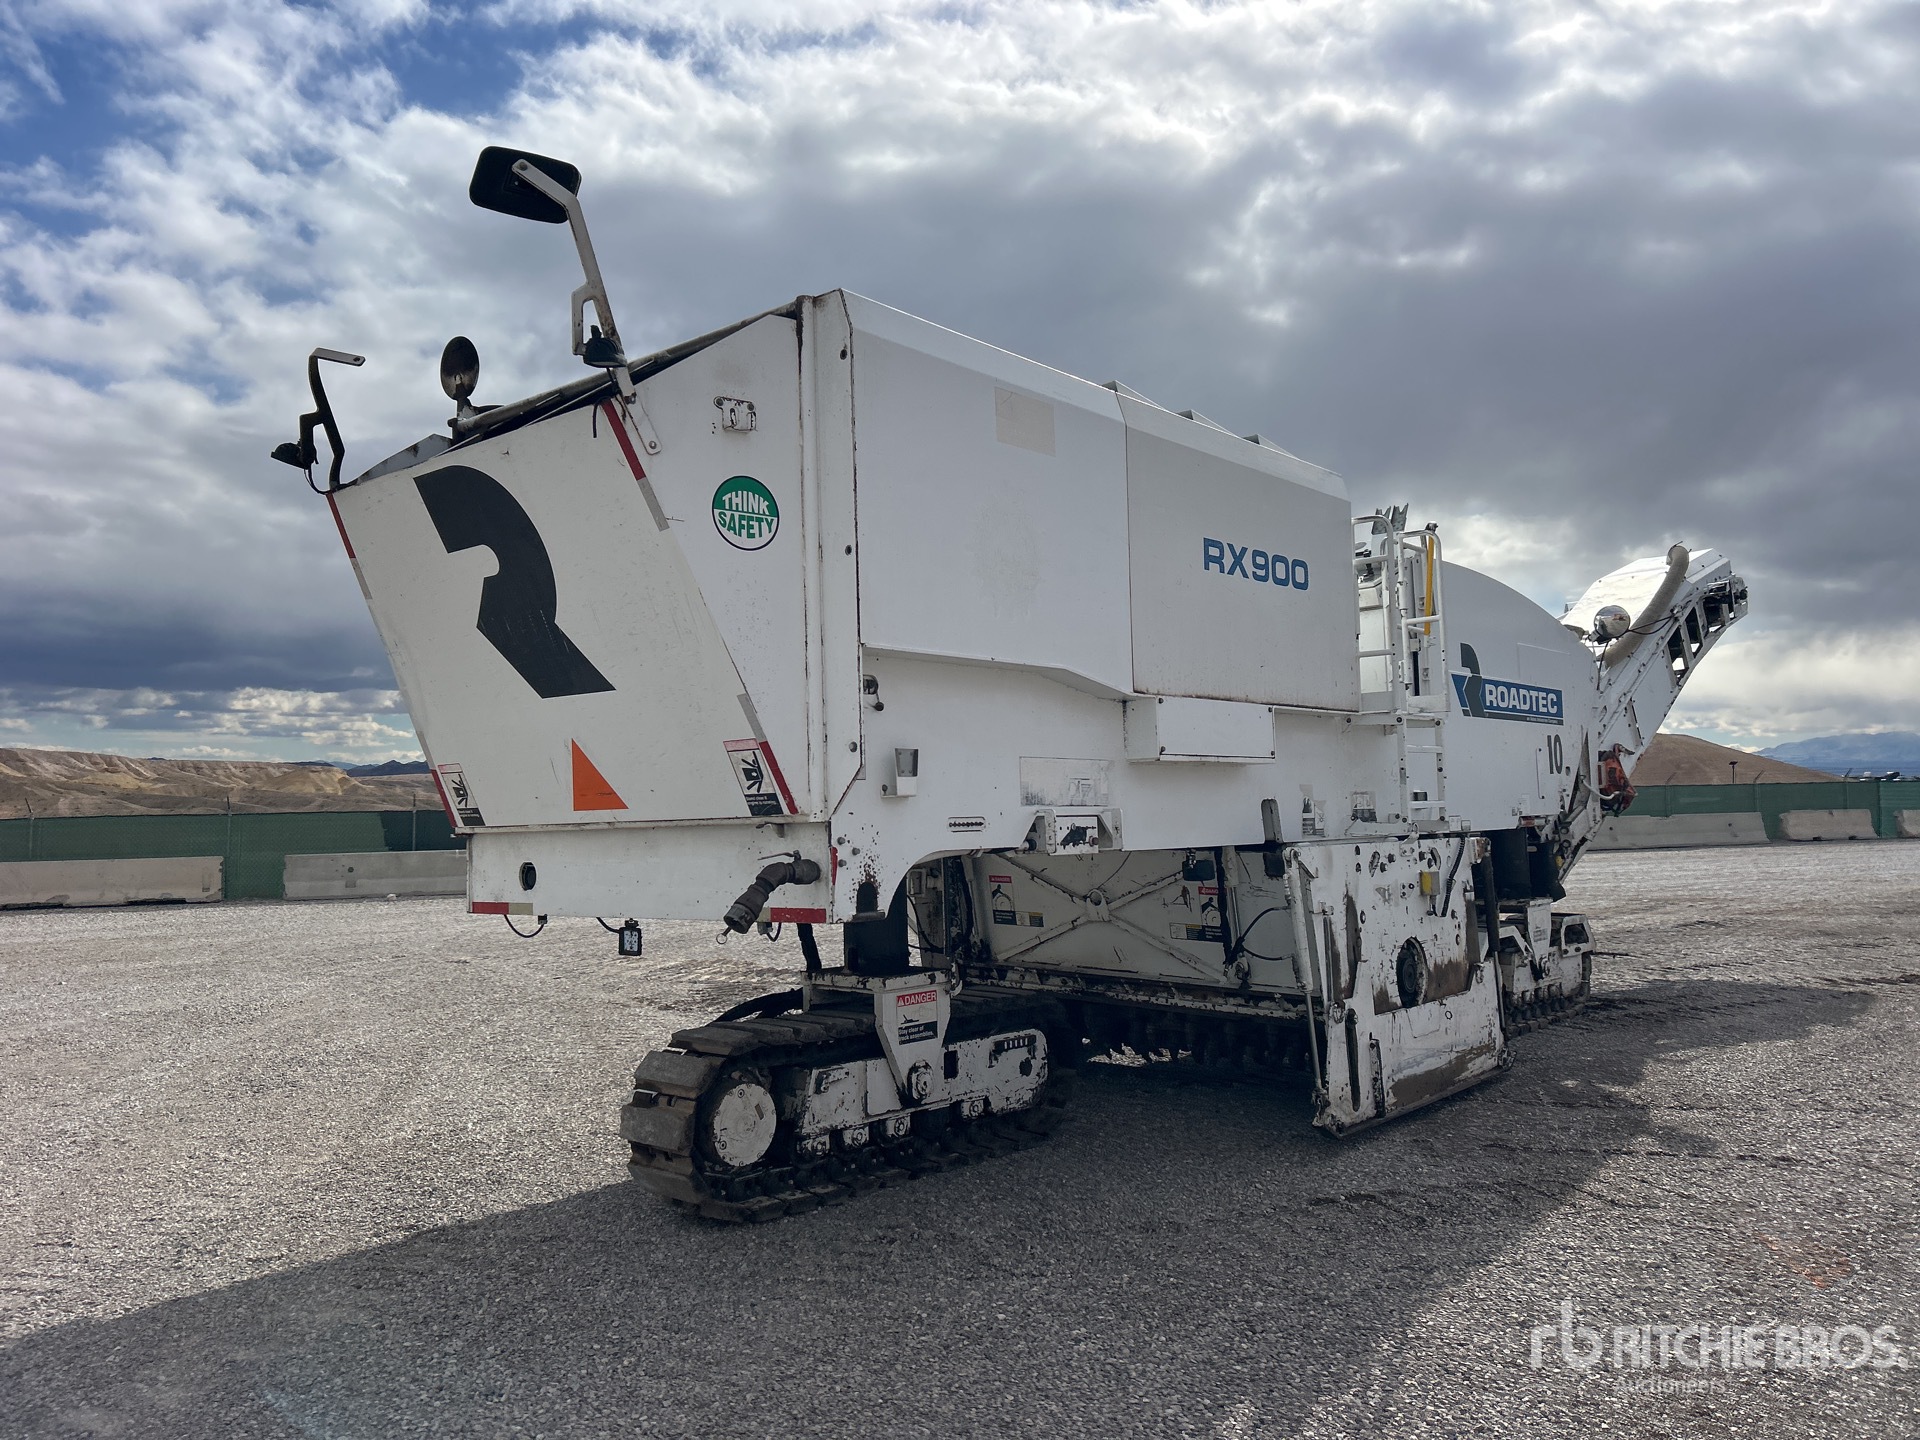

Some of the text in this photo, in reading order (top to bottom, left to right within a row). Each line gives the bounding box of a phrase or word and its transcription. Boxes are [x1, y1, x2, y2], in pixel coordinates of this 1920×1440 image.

[722, 490, 770, 515] THINK
[718, 511, 775, 539] SAFETY
[1203, 537, 1309, 591] RX900
[1484, 683, 1559, 714] ROADTEC
[1546, 734, 1563, 775] 10
[904, 991, 937, 1005] DANGER
